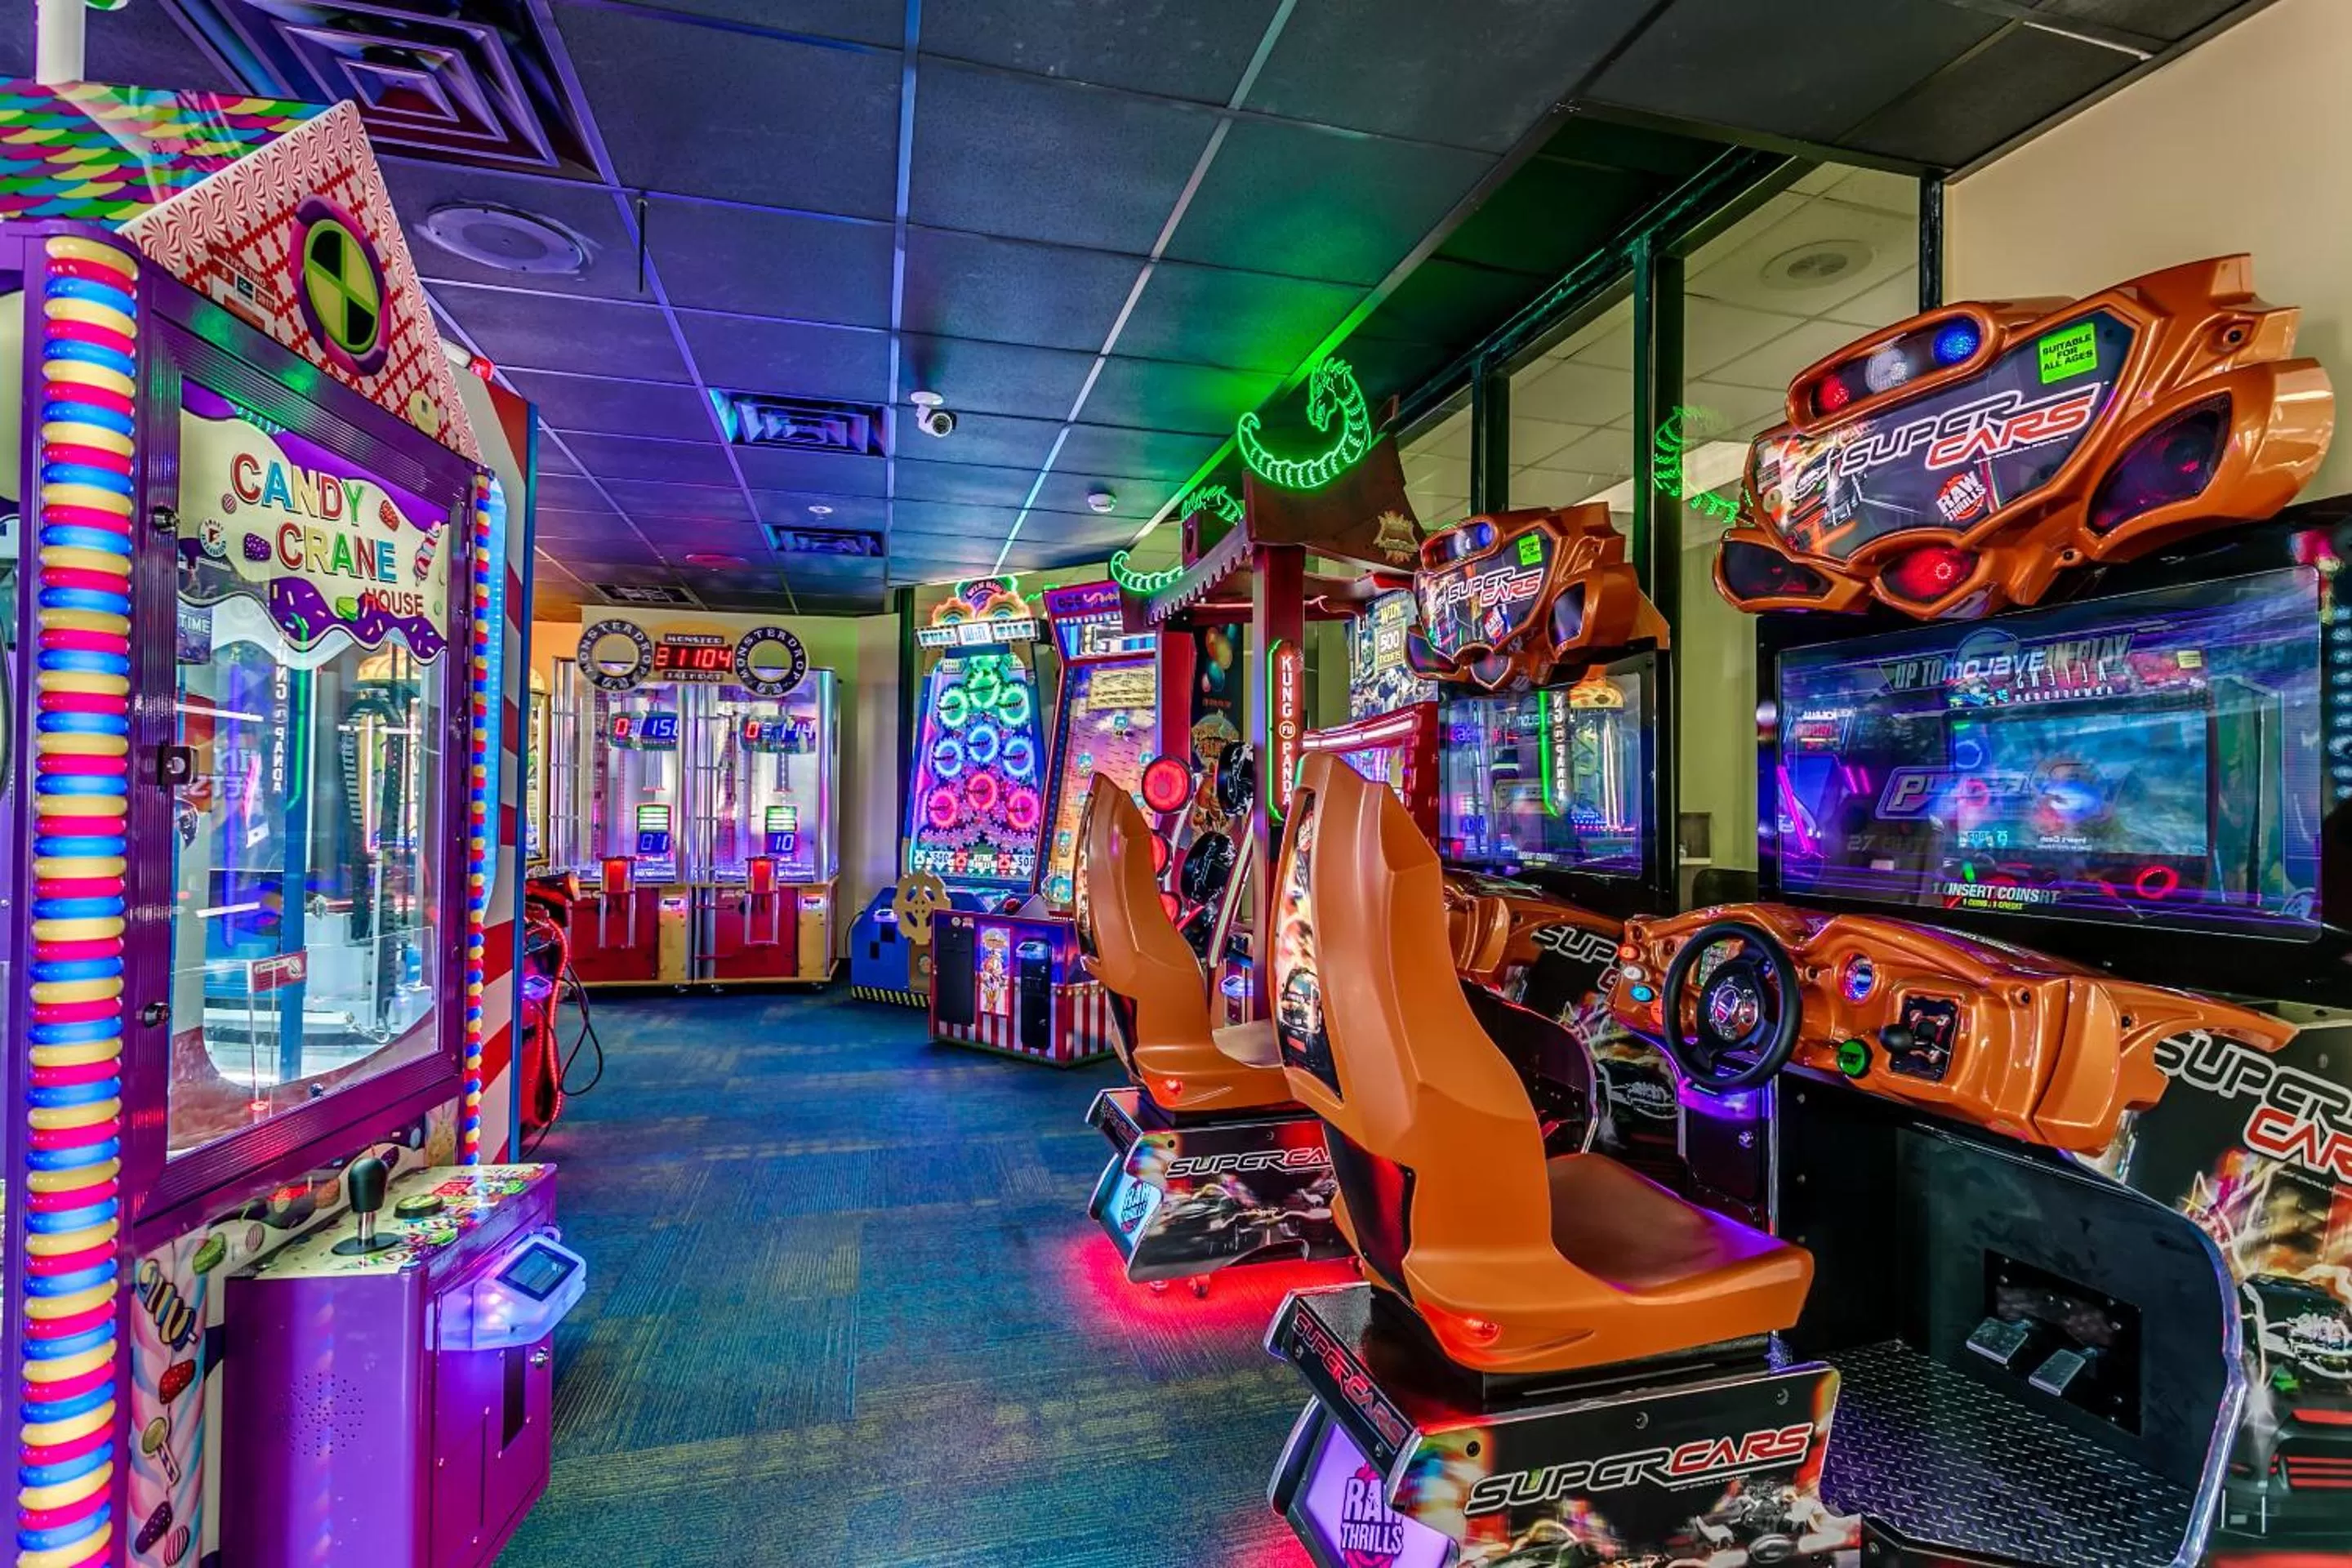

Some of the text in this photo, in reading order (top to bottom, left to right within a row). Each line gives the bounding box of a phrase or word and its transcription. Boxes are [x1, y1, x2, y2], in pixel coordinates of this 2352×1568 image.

[2042, 333, 2092, 355] SUITABLE
[2056, 347, 2078, 359] FOR
[2043, 361, 2062, 372] ALL
[1840, 390, 2021, 476] SUPER
[1925, 394, 2092, 471] CARS
[230, 453, 364, 526] CANDY
[1936, 471, 1980, 513] RAW
[276, 521, 397, 583] CRANE
[364, 586, 425, 617] HOUSE
[1448, 566, 1516, 604] SUPER
[1480, 573, 1542, 607] CARS
[920, 630, 955, 643] FULL
[996, 623, 1031, 639] TILT
[1379, 630, 1400, 653] 500
[1281, 655, 1294, 717] KUNG
[1893, 662, 1918, 688] UP
[1282, 742, 1294, 805] PANDA
[1949, 882, 1994, 899] INSERT
[1997, 887, 2039, 902] COINS
[2243, 1102, 2352, 1184] CAR
[1343, 1476, 1398, 1522] RAW
[1340, 1521, 1404, 1556] THRILLS
